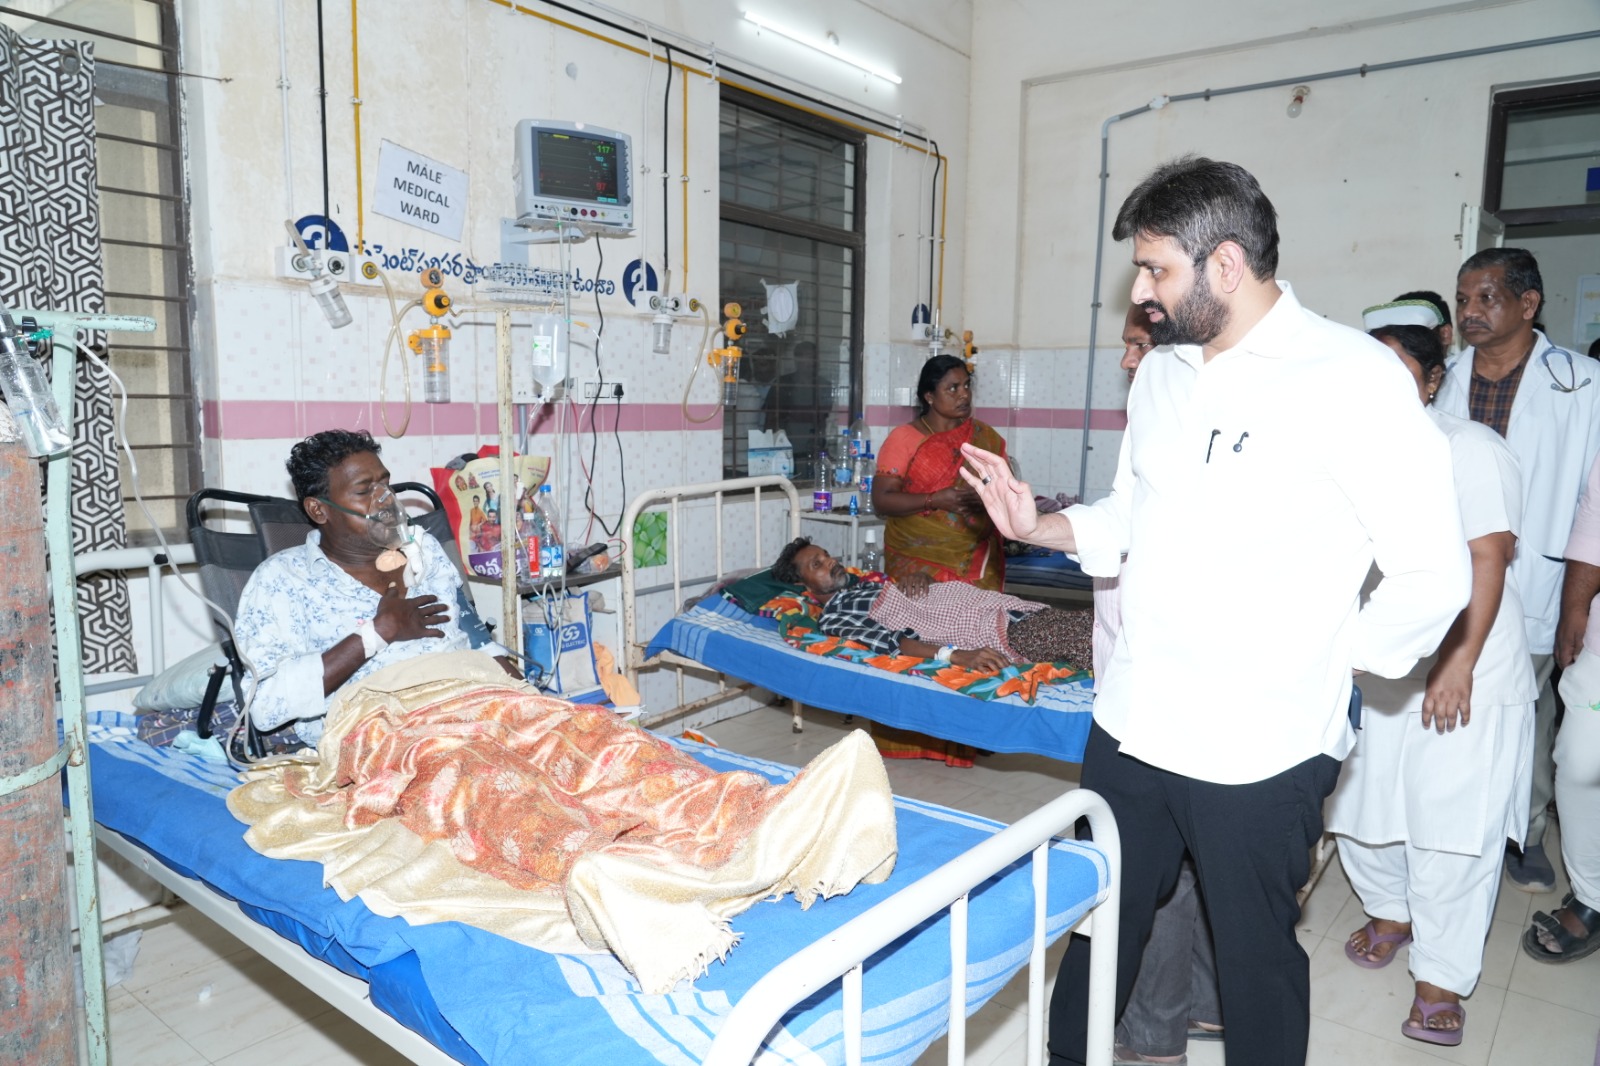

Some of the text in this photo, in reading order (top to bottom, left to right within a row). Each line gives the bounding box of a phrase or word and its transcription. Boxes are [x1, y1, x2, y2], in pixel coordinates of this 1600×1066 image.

[597, 145, 610, 153] 117
[407, 160, 443, 185] MALE
[393, 177, 450, 208] MEDICAL
[596, 182, 607, 190] 97
[400, 200, 440, 224] WARD
[528, 537, 536, 550] AQUA
